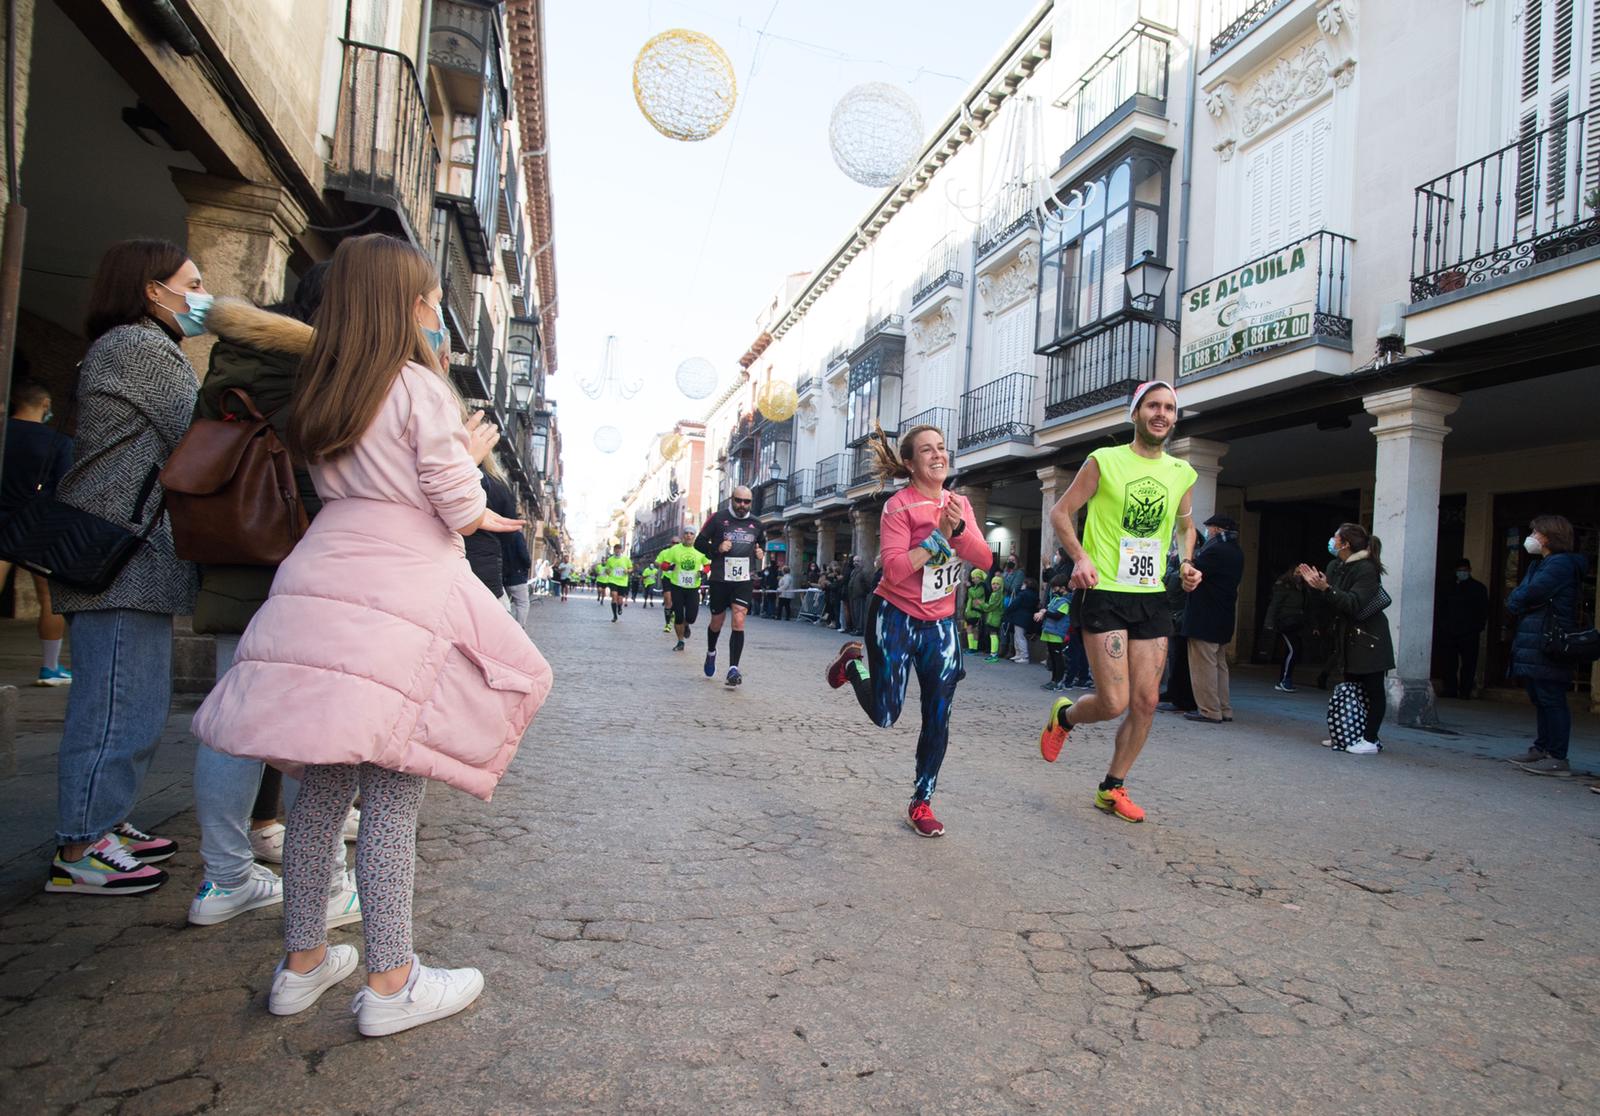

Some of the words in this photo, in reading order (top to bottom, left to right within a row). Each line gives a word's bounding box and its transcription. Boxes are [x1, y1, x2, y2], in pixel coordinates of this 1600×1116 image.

[1189, 287, 1210, 312] SE
[1216, 247, 1305, 302] ALQUILA
[1195, 348, 1210, 368] 888
[1250, 325, 1269, 345] 881
[1272, 320, 1287, 340] 32
[1292, 315, 1307, 336] 00
[934, 562, 962, 590] 312
[1129, 555, 1154, 577] 395
